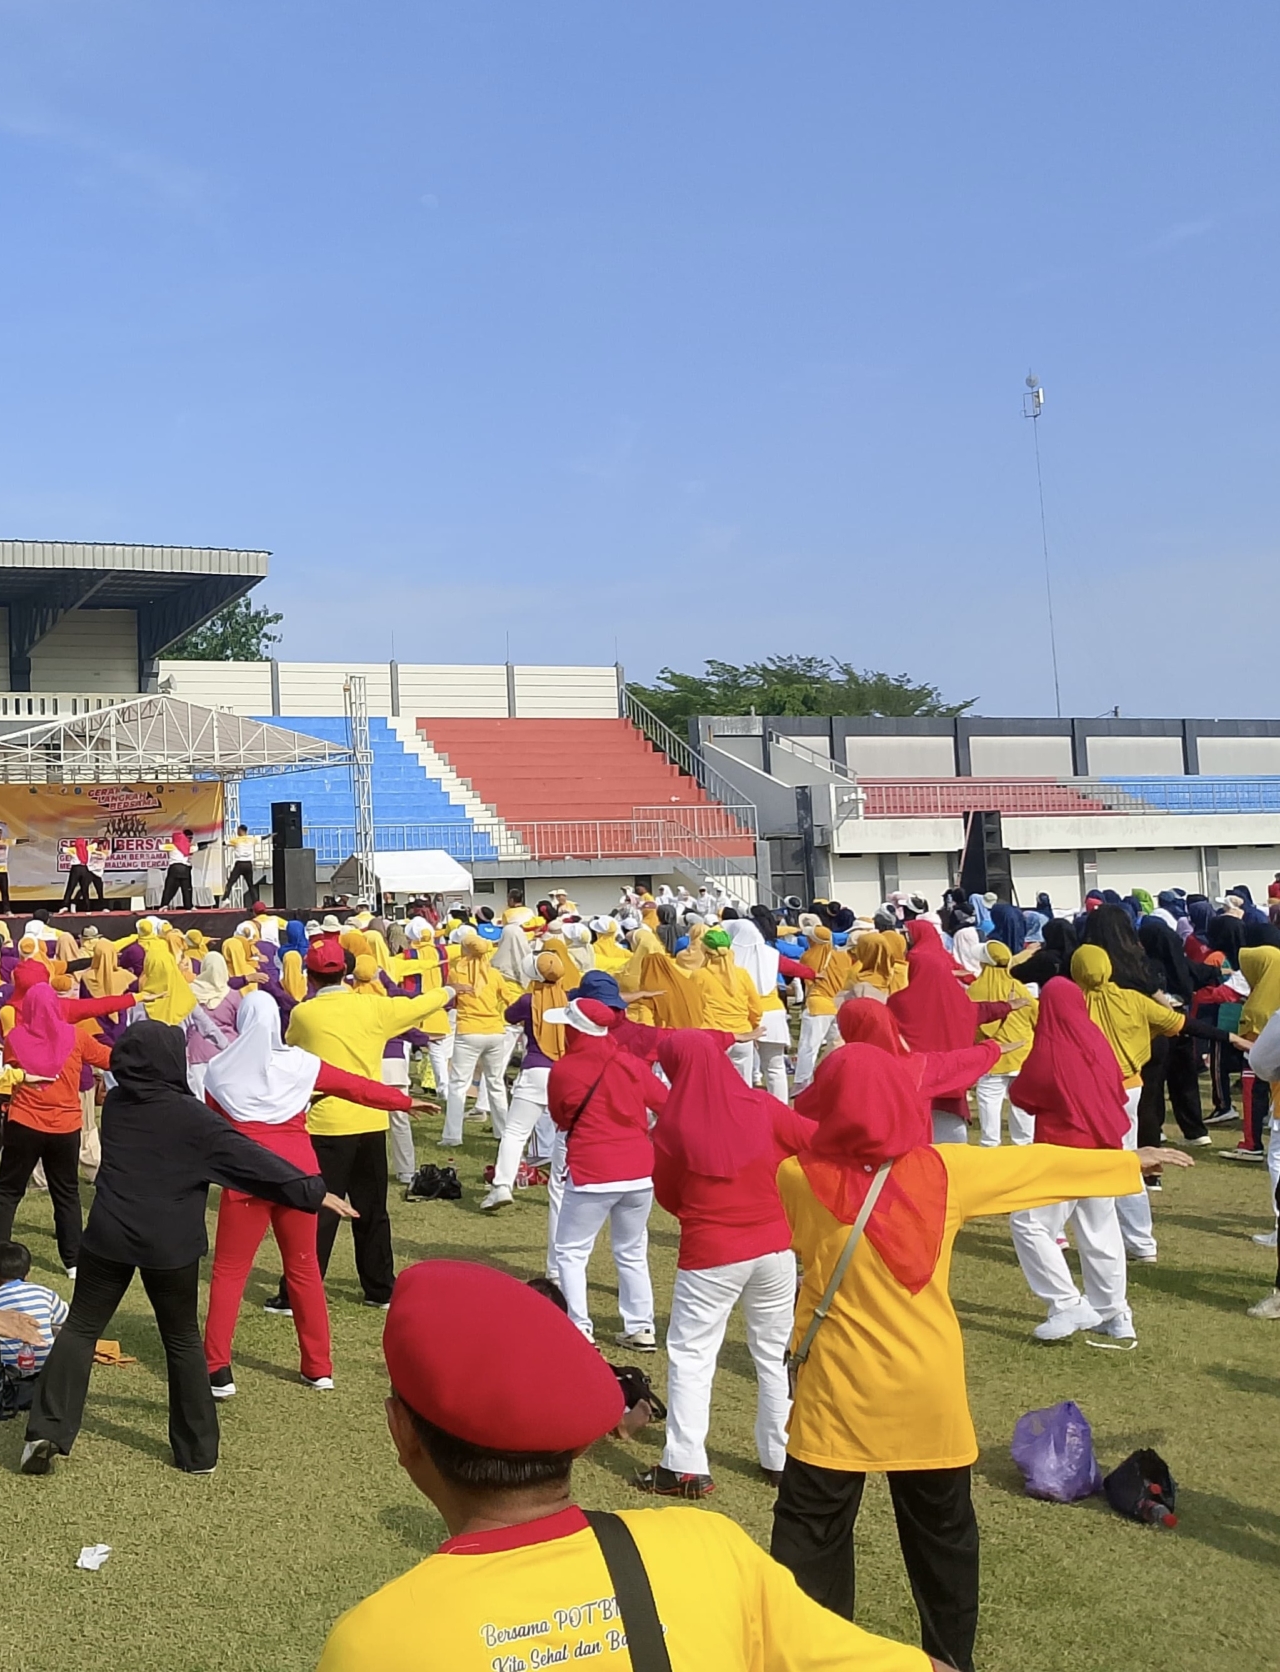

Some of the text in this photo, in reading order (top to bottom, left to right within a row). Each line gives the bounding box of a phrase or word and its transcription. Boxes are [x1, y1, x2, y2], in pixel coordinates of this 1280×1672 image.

[88, 787, 121, 797] GERAK
[98, 791, 147, 803] LANGKAH
[110, 799, 158, 810] BERSAMA
[129, 852, 167, 861] BERSAMA
[481, 1621, 550, 1647] Bersama
[492, 1655, 526, 1672] Kita
[530, 1643, 568, 1669] Sehat
[574, 1640, 602, 1658] dan
